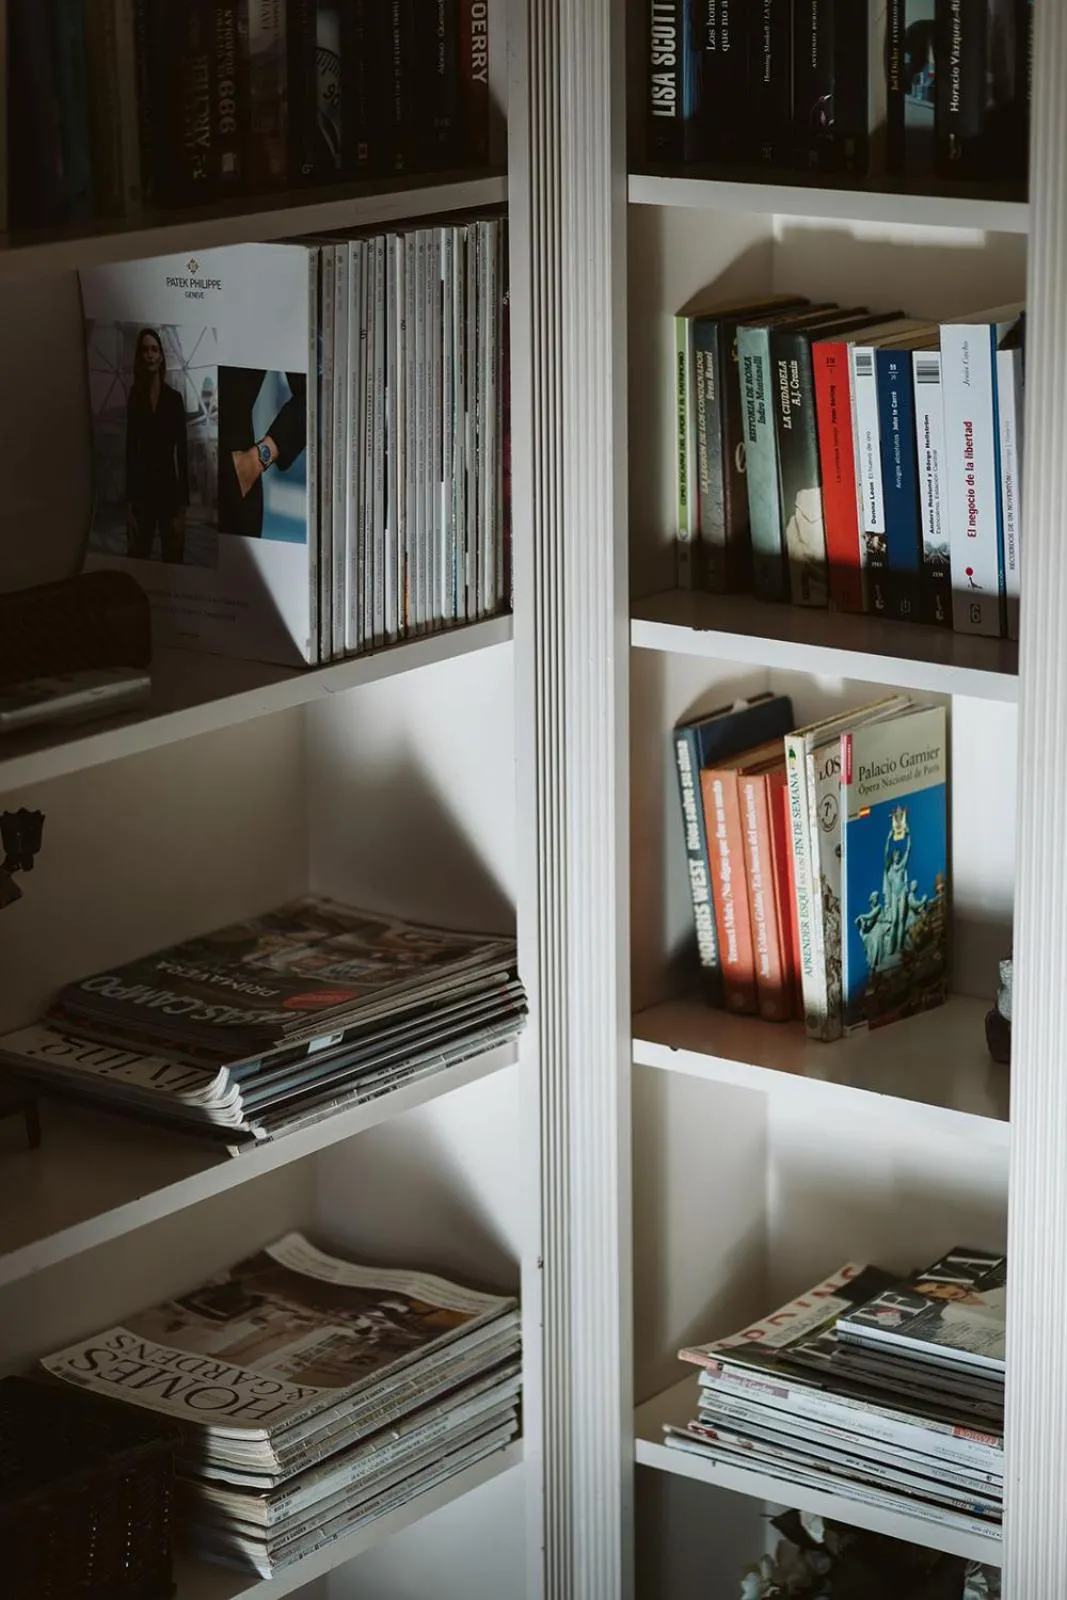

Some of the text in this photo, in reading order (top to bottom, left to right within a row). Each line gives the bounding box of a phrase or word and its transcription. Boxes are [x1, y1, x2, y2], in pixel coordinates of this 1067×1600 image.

[706, 29, 716, 51] Los
[721, 11, 729, 26] no
[721, 29, 732, 52] que
[471, 0, 487, 83] OERRY
[650, 73, 677, 117] LISA
[949, 67, 961, 112] Horacio
[166, 276, 222, 290] PATEK PHILIPPE
[753, 355, 765, 401] Montanelli
[778, 360, 793, 430] LA CIUDADELA
[789, 360, 800, 389] Cronin
[744, 356, 758, 442] HISTORIA DE ROMA
[892, 416, 900, 431] John
[962, 420, 979, 538] El negocio de la libertad
[858, 758, 898, 782] Palacio
[899, 745, 941, 769] Garnier
[882, 772, 913, 788] Nacional
[789, 773, 801, 822] SEMANA
[793, 821, 803, 838] DE
[794, 838, 805, 857] FIN
[689, 858, 709, 904] WEST
[693, 903, 717, 967] MORRIS
[803, 920, 814, 977] APRENDER
[80, 975, 205, 1015] CAMPO
[155, 960, 282, 998] PRIMAVERA
[843, 1256, 1005, 1329] TEVA
[68, 1347, 289, 1421] HOMES
[105, 1333, 284, 1397] GARDENS
